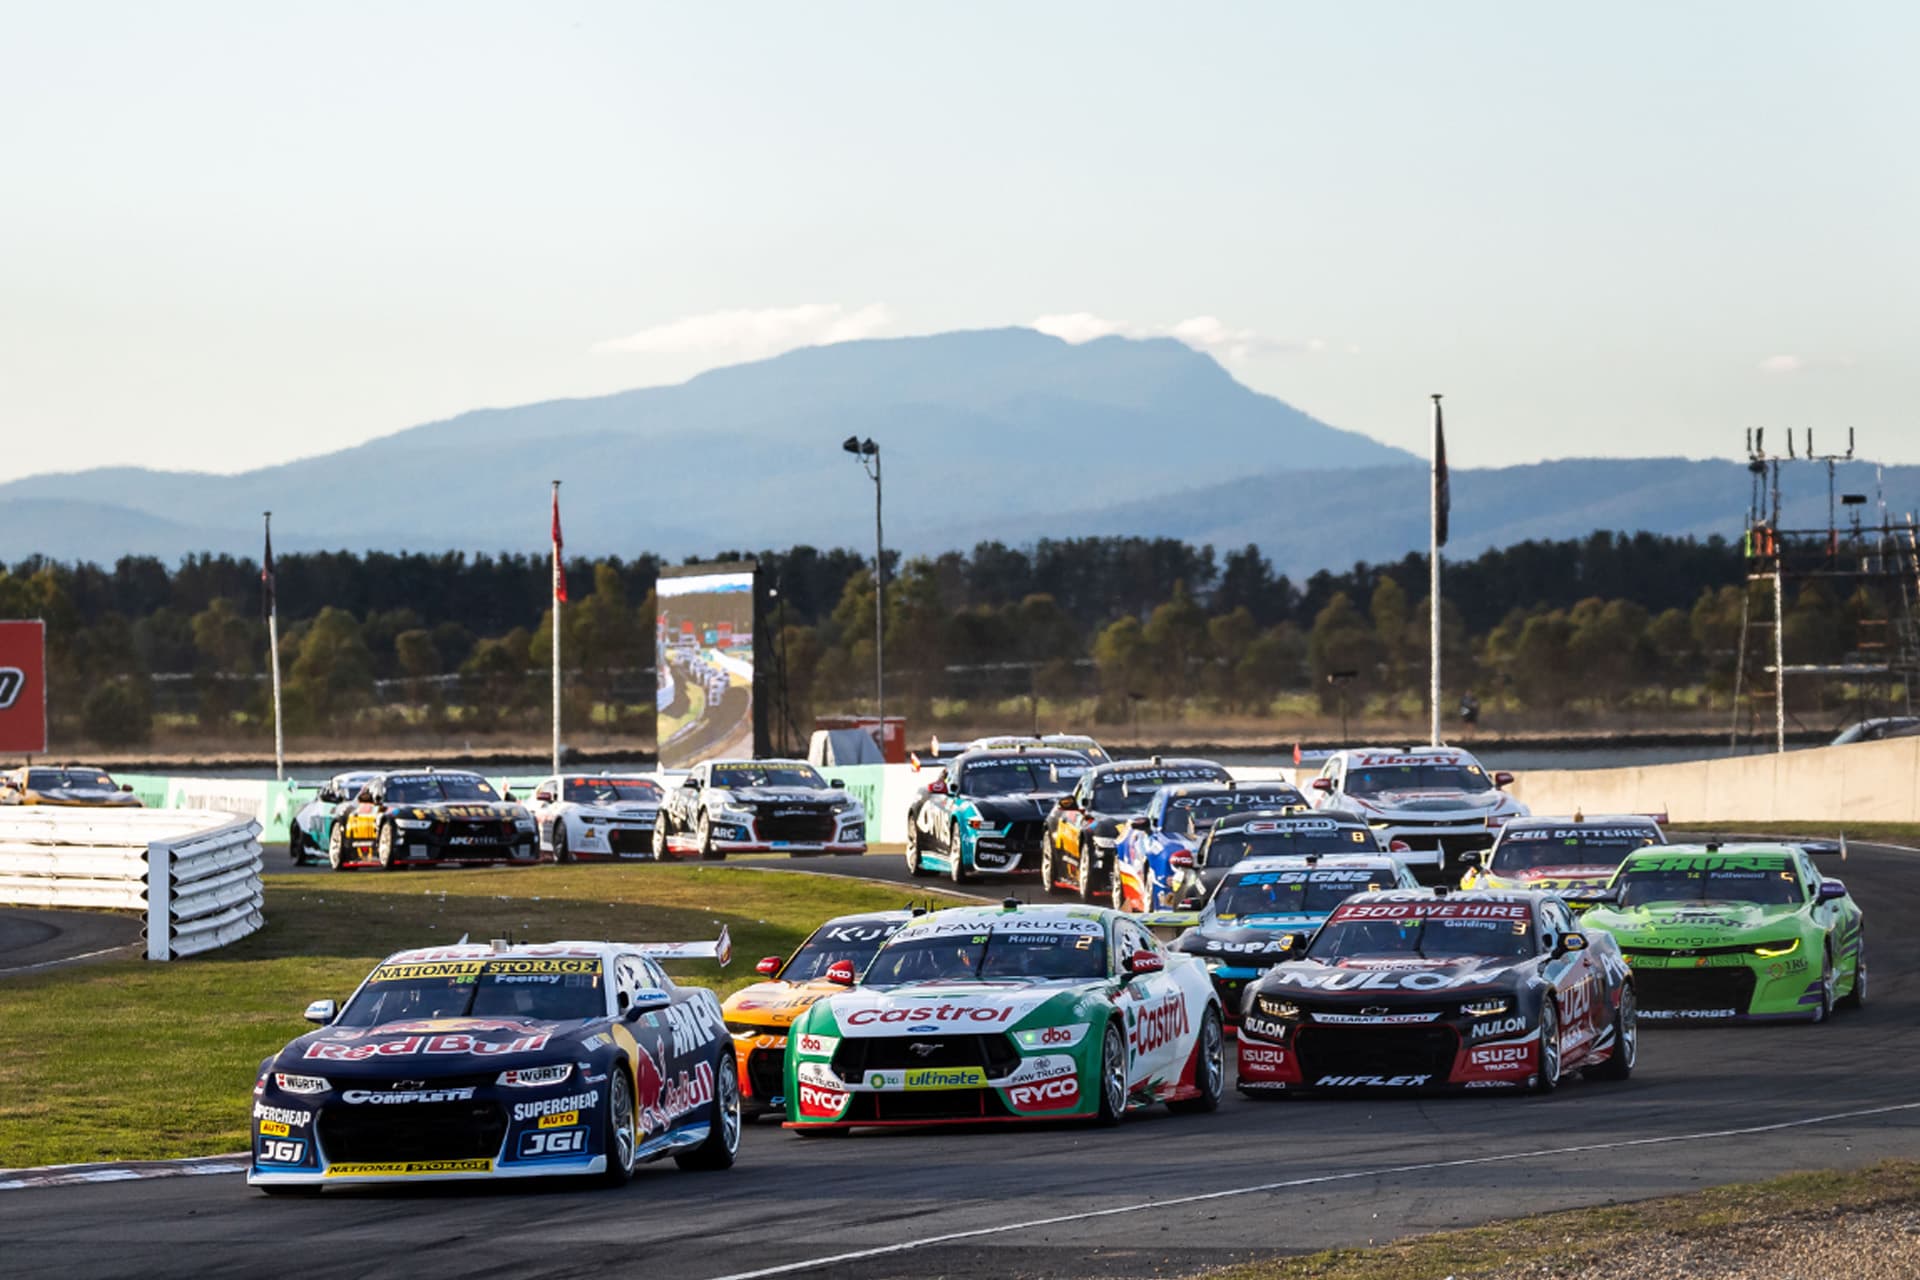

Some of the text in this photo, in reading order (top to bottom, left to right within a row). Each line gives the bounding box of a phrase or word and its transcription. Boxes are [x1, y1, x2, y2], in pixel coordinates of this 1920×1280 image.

[1362, 754, 1460, 766] Liberty
[1103, 768, 1197, 784] Steadfast
[1353, 831, 1365, 843] 8
[1554, 828, 1656, 839] BATTERIES
[1628, 858, 1786, 872] SHURE
[1338, 905, 1526, 919] 1300 WE HIRE
[936, 921, 1098, 934] FAW TRUCKS
[1444, 920, 1497, 930] Golding
[1512, 922, 1527, 936] 3
[1008, 935, 1058, 944] Randle
[1075, 935, 1093, 950] 2
[376, 959, 594, 980] NATIONAL STORAGE
[1134, 956, 1164, 968] RYCO
[495, 974, 561, 985] Feeney
[847, 1004, 1015, 1027] Castrol
[1137, 991, 1190, 1057] Castrol
[1245, 1016, 1286, 1039] NULON
[1471, 1015, 1527, 1038] NULON
[801, 1034, 822, 1051] dba
[1041, 1028, 1072, 1044] dba
[302, 1035, 425, 1062] Red
[421, 1032, 553, 1056] Bull
[1243, 1049, 1285, 1064] ISUZU
[1471, 1047, 1529, 1064] ISUZU
[518, 1066, 569, 1082] WÜRTH
[908, 1071, 980, 1086] ultimate
[1036, 1065, 1073, 1080] TRUCKS
[1315, 1074, 1432, 1087] HIFLEX
[341, 1086, 478, 1105] COMPLETE
[800, 1086, 850, 1111] RYCO
[1010, 1078, 1079, 1106] RYCO
[513, 1089, 600, 1122] SUPERCHEAP
[542, 1114, 575, 1126] AUTO
[262, 1123, 287, 1134] AUTO
[522, 1130, 584, 1155] JGI
[259, 1140, 304, 1162] JGI
[329, 1160, 487, 1175] NATIONAL STORAGE
